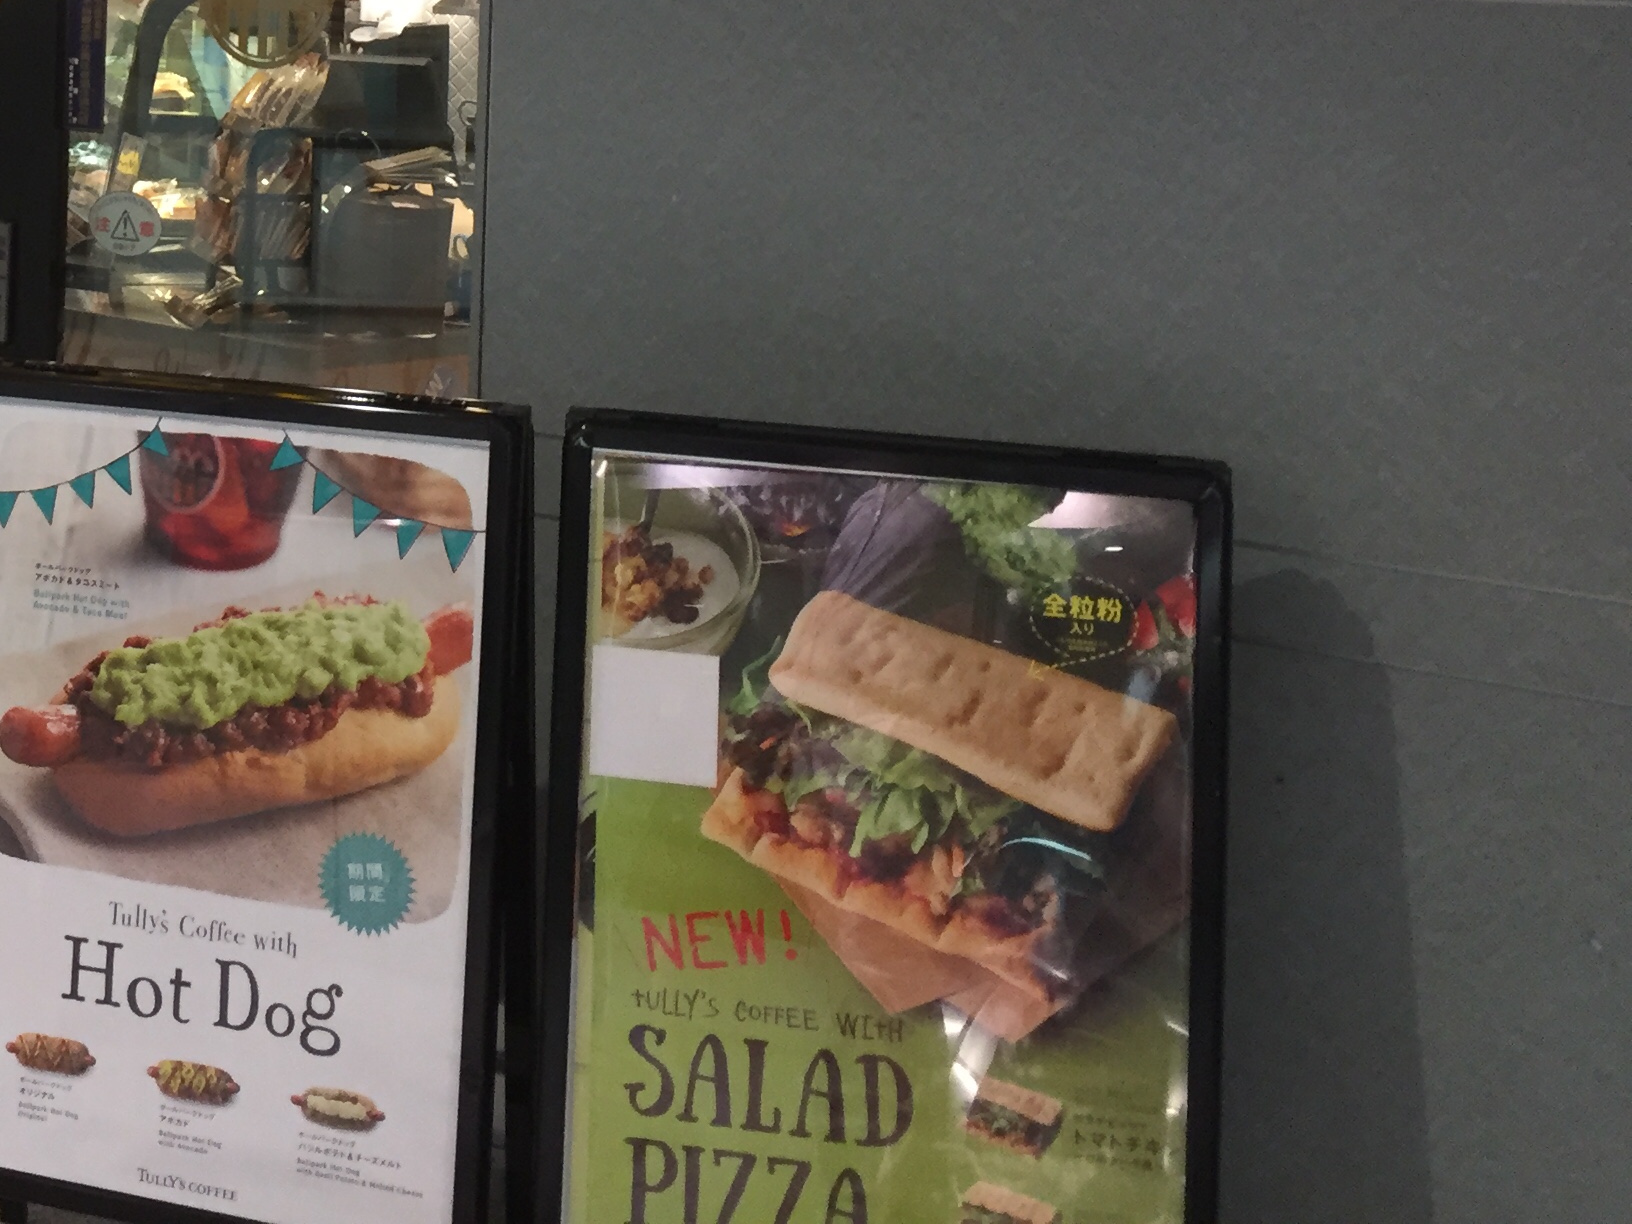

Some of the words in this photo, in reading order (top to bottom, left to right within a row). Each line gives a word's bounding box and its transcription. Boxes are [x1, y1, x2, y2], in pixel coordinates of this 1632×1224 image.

[1042, 592, 1123, 624] 全粒粉
[108, 901, 169, 935] Tully's
[179, 914, 246, 945] Coffee
[253, 931, 298, 959] with
[641, 907, 798, 972] NEW!
[61, 934, 192, 1024] Hot
[213, 958, 344, 1057] Dog
[733, 999, 820, 1032] COFFEE
[623, 1024, 915, 1148] SALAD
[623, 1137, 868, 1224] PIZZA
